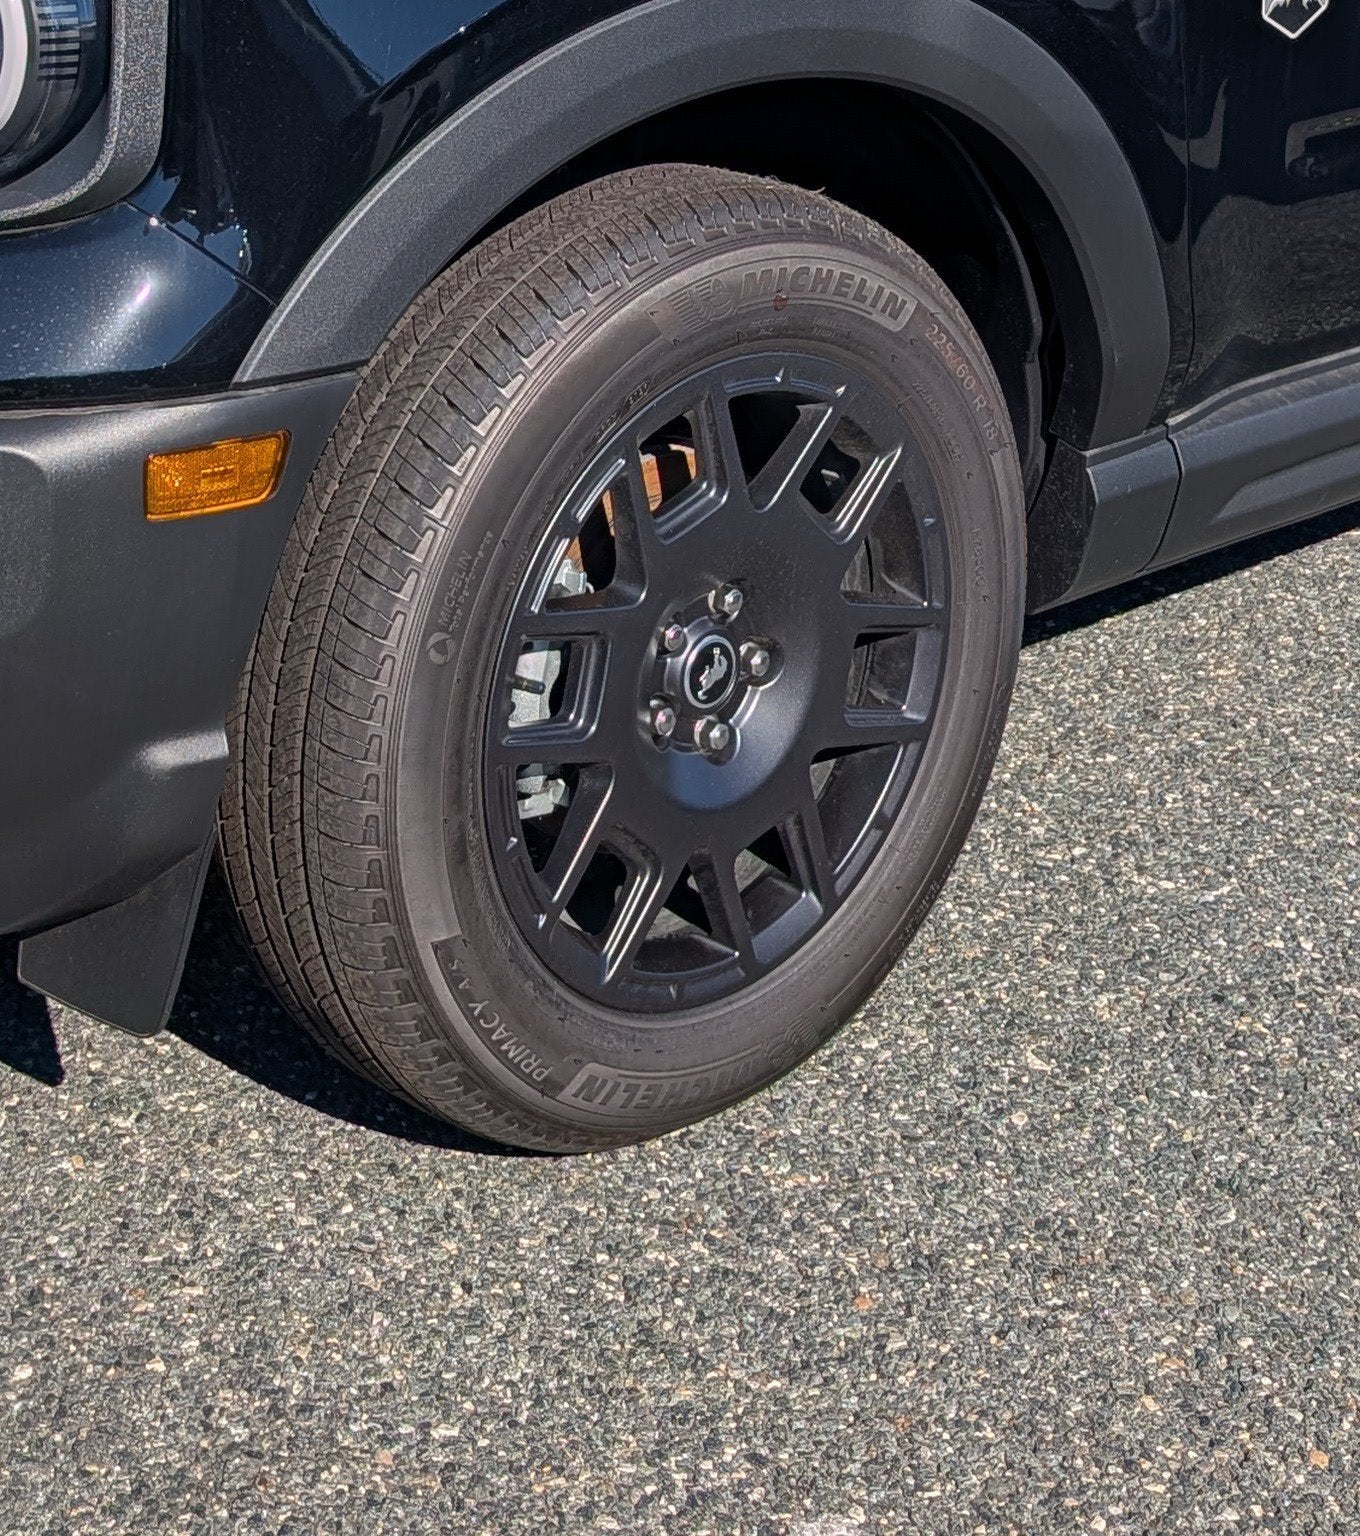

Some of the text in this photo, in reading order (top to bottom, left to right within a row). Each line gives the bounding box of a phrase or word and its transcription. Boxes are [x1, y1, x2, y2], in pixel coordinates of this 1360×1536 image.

[741, 265, 908, 322] MICHELIN
[925, 323, 978, 392] 225/60
[972, 394, 988, 413] R
[438, 550, 472, 627] MICHELIN
[468, 999, 554, 1082] PRIMACY
